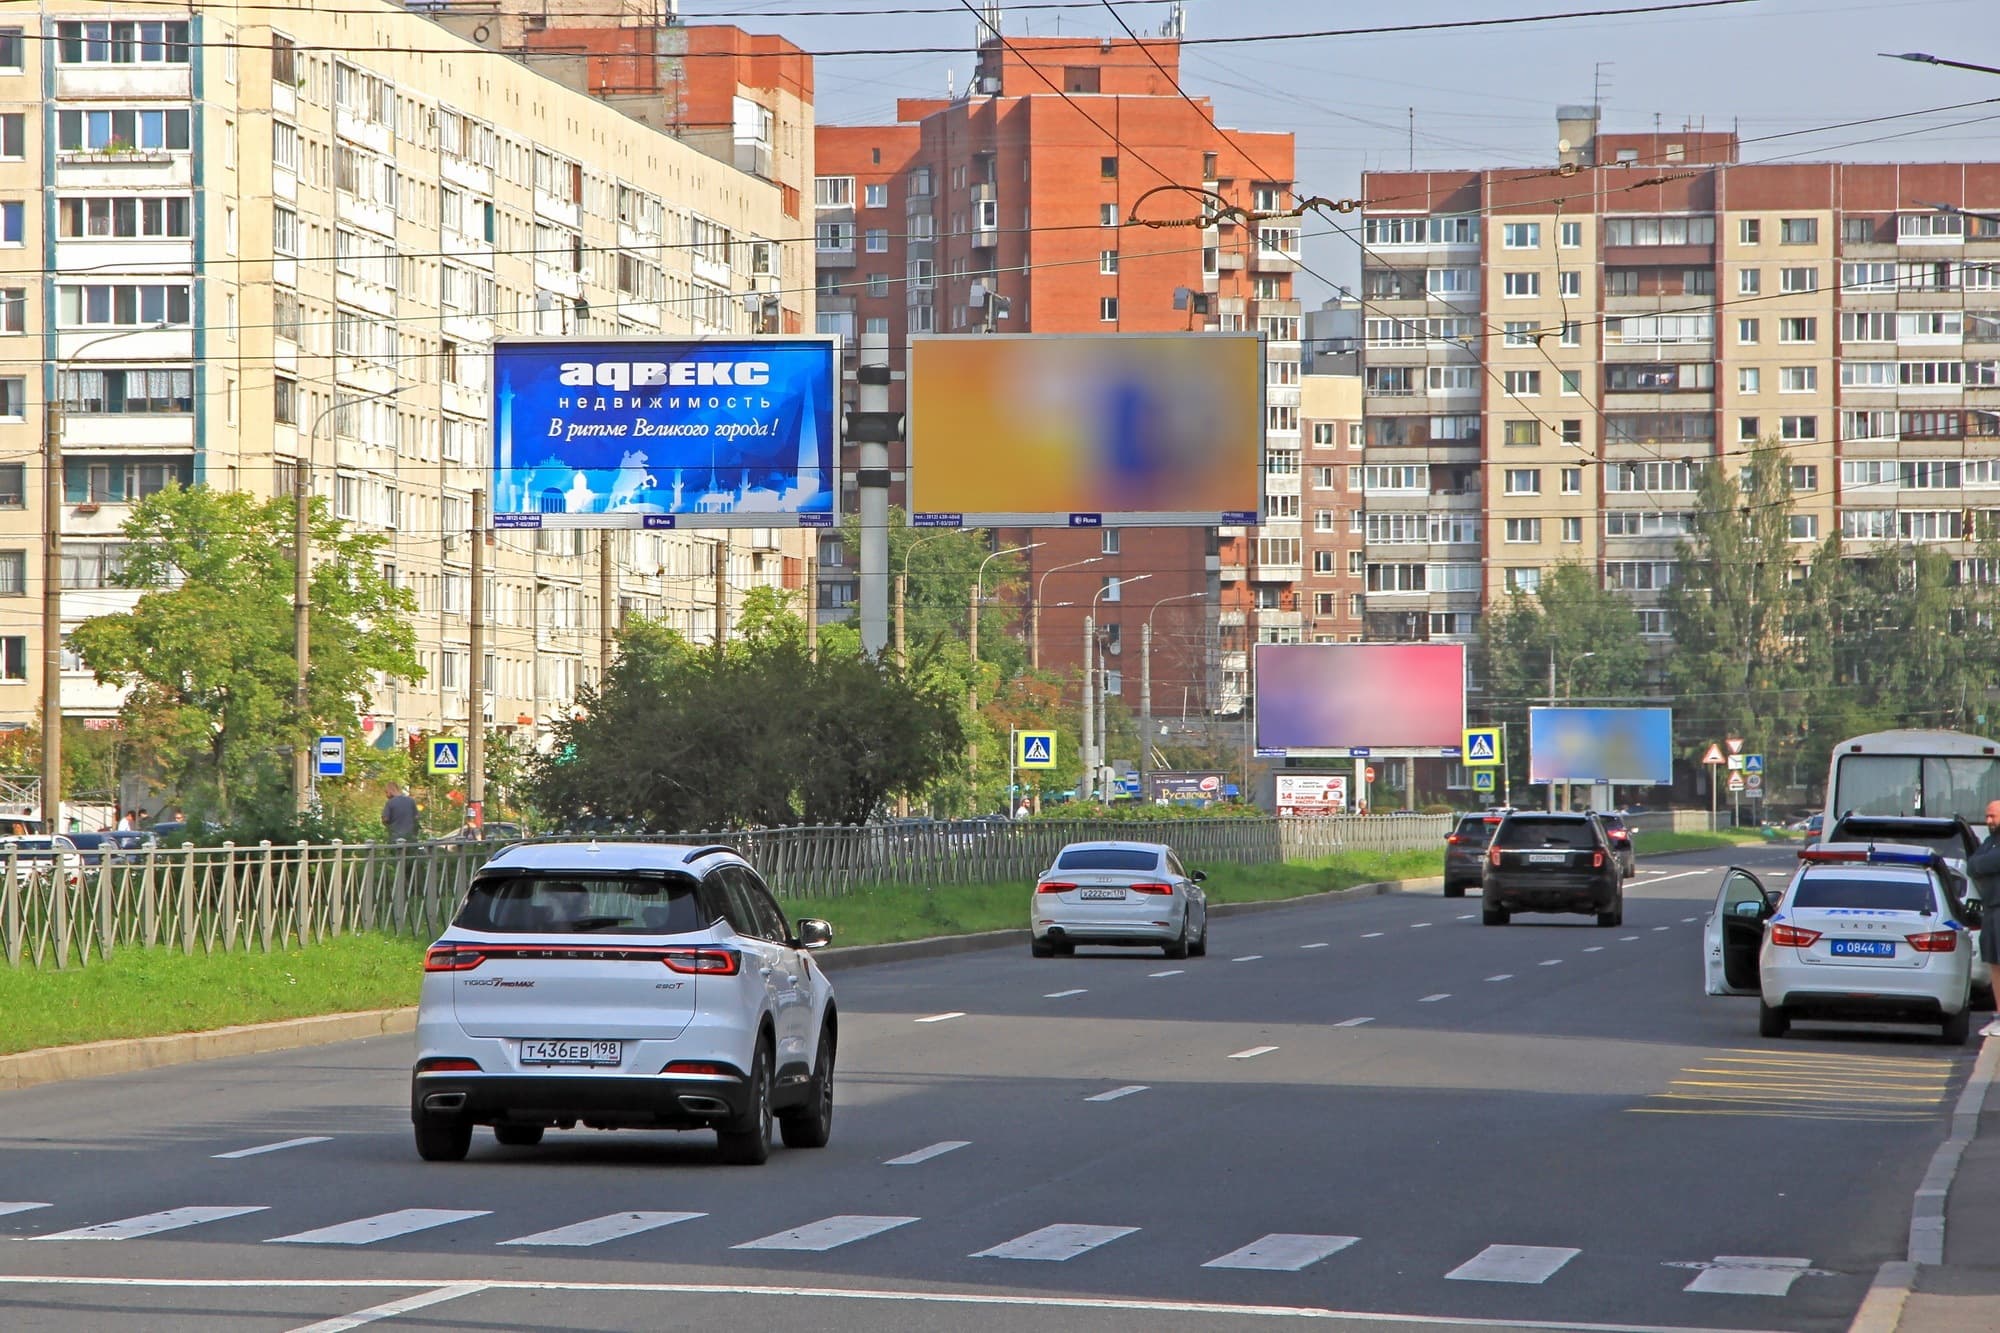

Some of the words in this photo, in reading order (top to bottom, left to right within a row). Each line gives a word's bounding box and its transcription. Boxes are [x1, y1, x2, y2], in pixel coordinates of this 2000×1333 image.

[559, 397, 771, 411] недвижимость
[547, 418, 563, 437] В
[565, 421, 628, 442] ритме
[632, 418, 709, 437] Великого
[1847, 942, 1875, 953] 0844
[516, 950, 629, 958] CHERY
